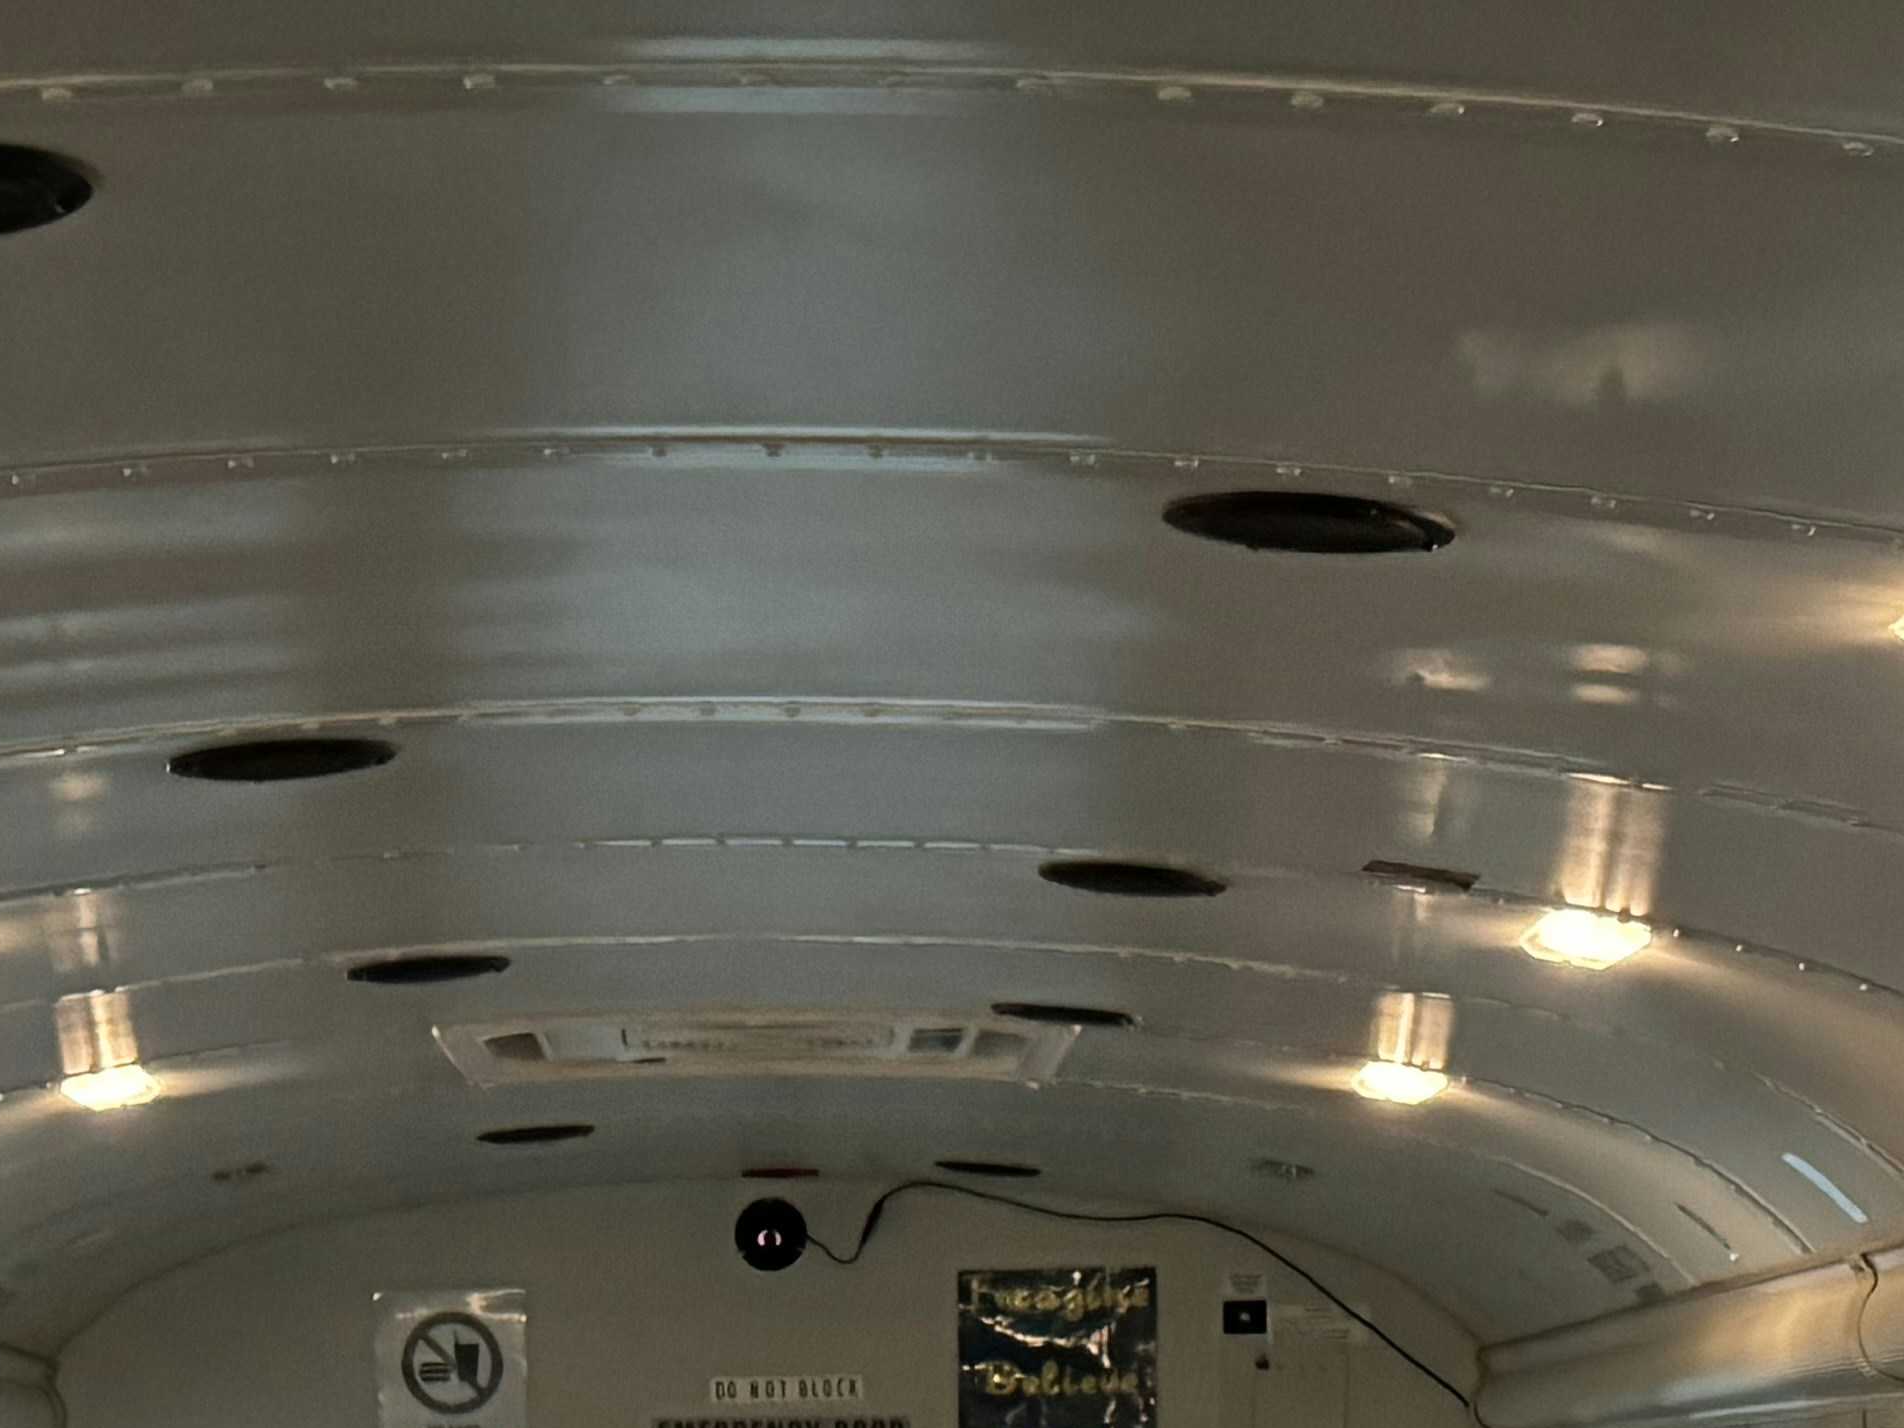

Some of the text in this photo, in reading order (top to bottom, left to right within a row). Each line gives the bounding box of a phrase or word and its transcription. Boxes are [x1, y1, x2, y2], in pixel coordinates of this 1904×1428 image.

[714, 1377, 858, 1400] DO NOT BLOCK
